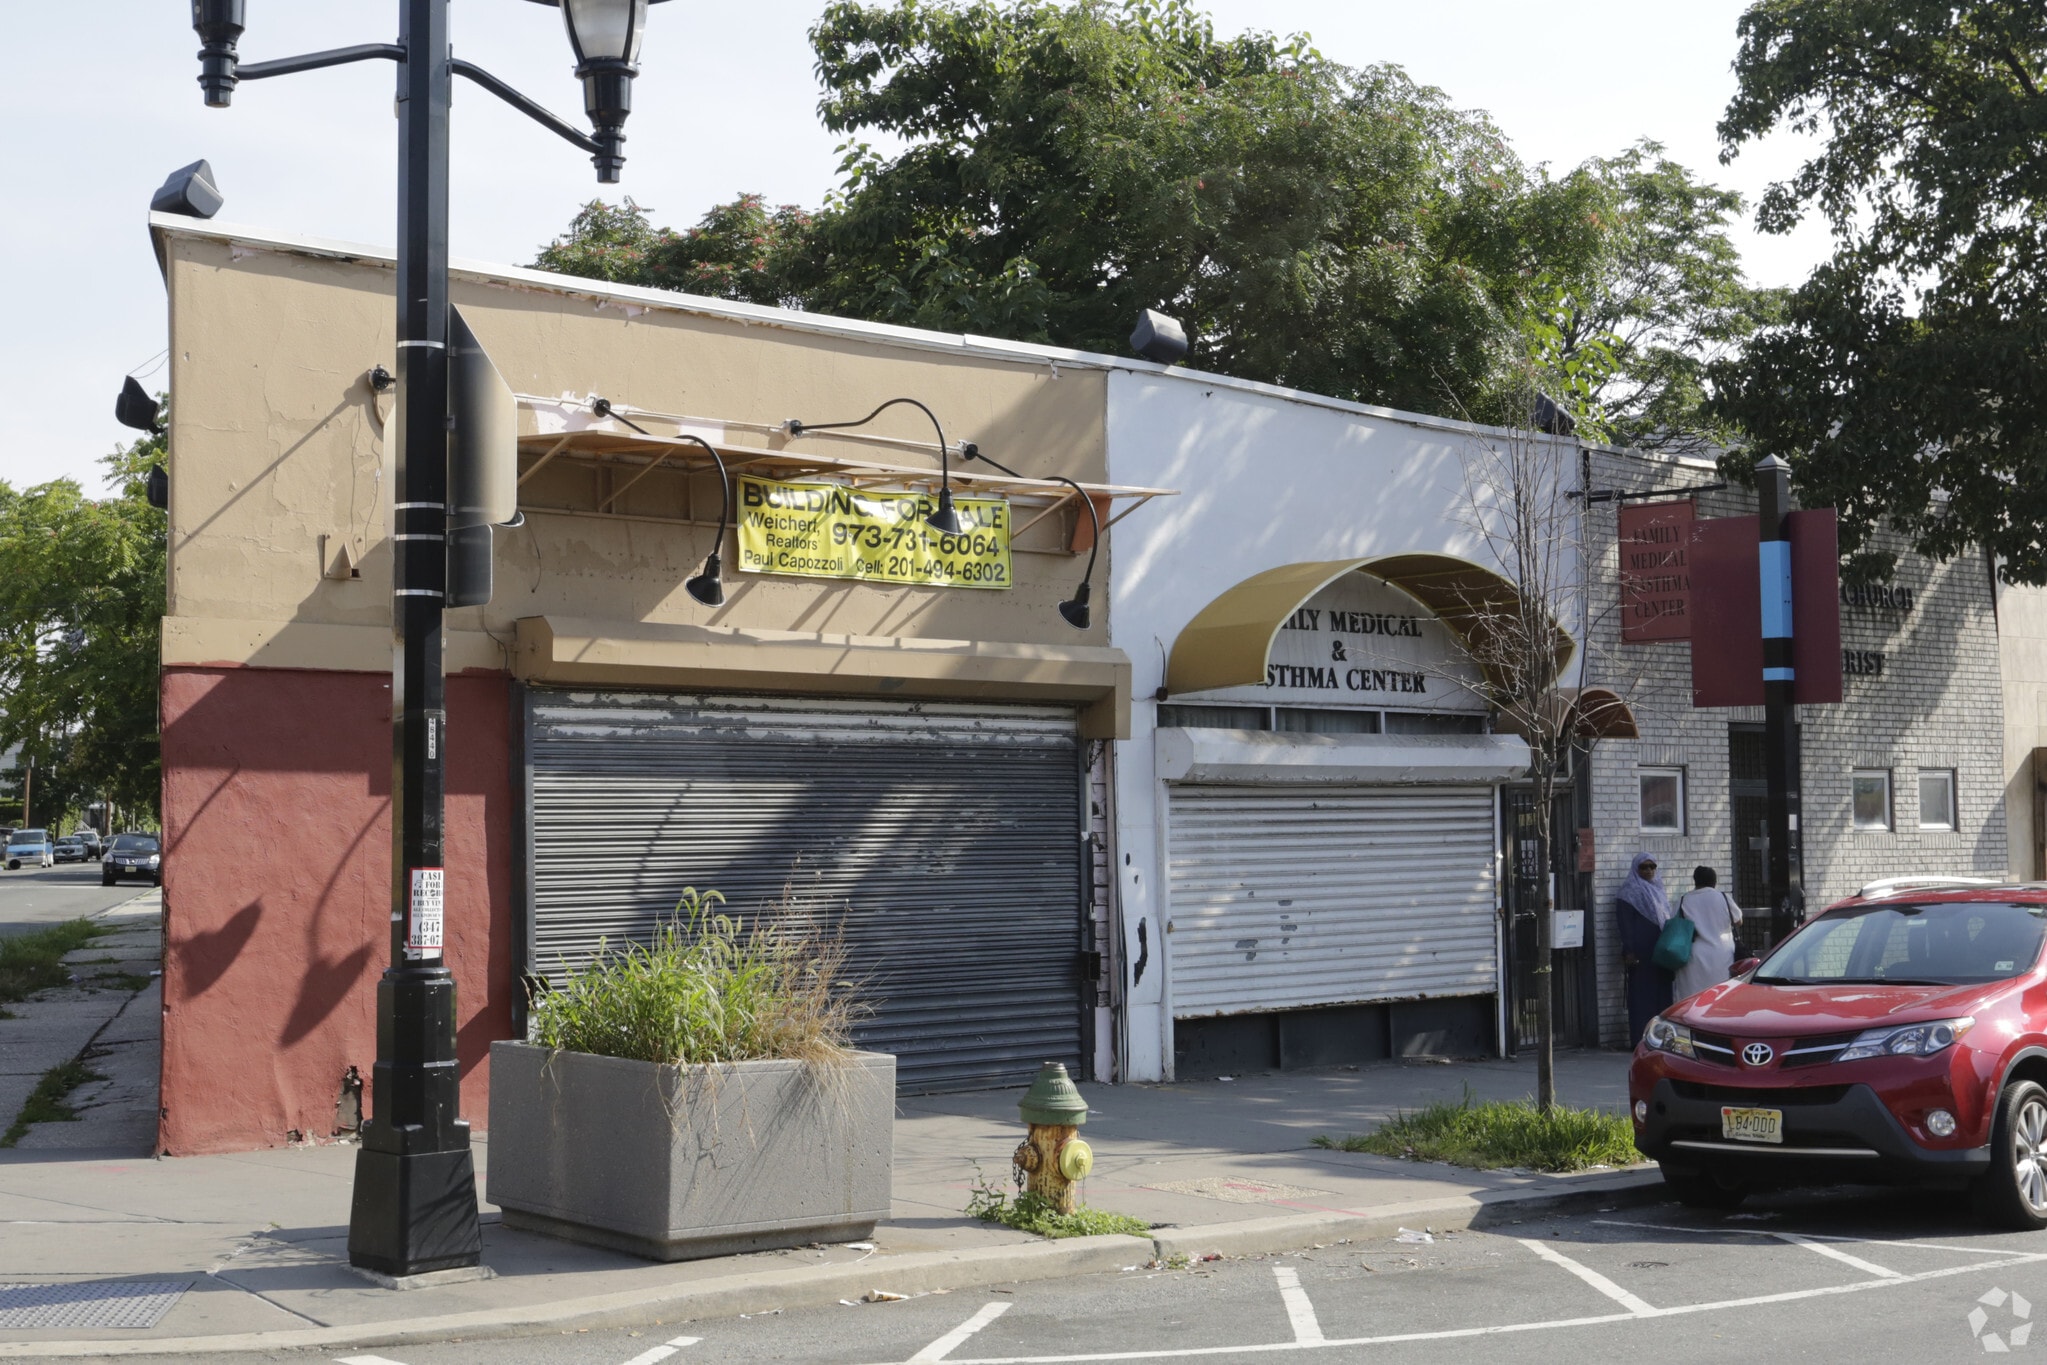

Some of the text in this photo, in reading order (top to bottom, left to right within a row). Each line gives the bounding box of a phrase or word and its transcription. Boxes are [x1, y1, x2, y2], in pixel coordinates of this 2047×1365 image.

[748, 511, 821, 536] Weichert,
[961, 505, 1003, 529] ALE
[766, 533, 819, 551] Realtors
[832, 522, 1000, 558] 973-731-6064
[1633, 525, 1681, 546] FAMILY
[743, 549, 1005, 583] Paul Capozzoli Cell: 201-494-6302
[1630, 549, 1687, 571] MEDICAL
[1634, 599, 1686, 619] CENTER
[1281, 608, 1423, 638] ILY MEDICAL
[1331, 640, 1348, 662] &
[1842, 649, 1885, 676] RIST
[1260, 664, 1427, 694] STHMA CENTER
